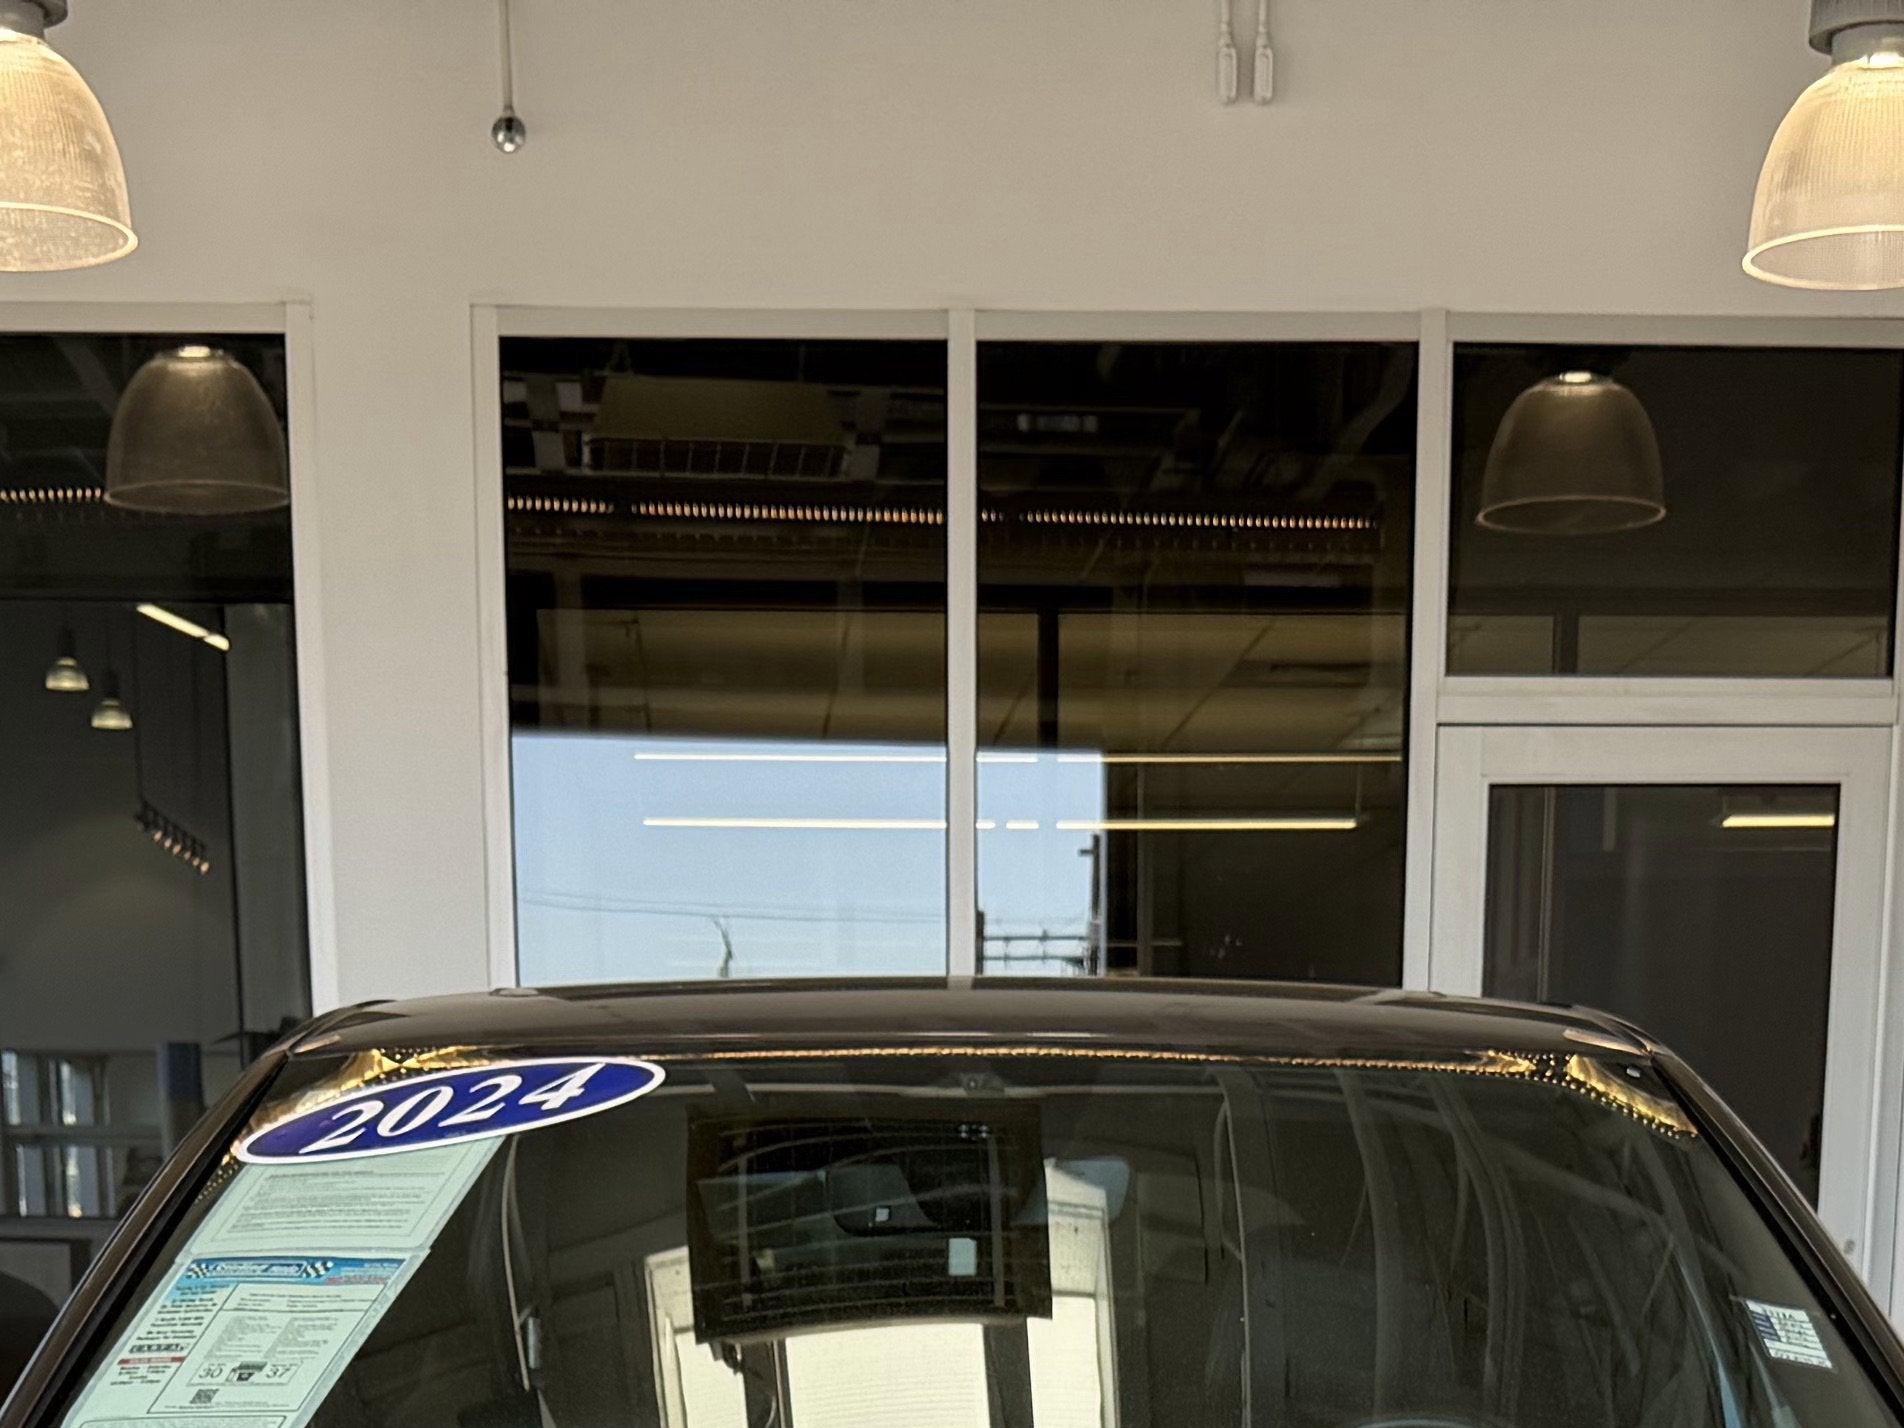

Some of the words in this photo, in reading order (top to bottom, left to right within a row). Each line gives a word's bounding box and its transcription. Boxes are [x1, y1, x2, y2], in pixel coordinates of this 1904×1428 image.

[299, 1062, 607, 1155] 2024
[199, 1367, 223, 1379] 30
[266, 1367, 291, 1379] 37
